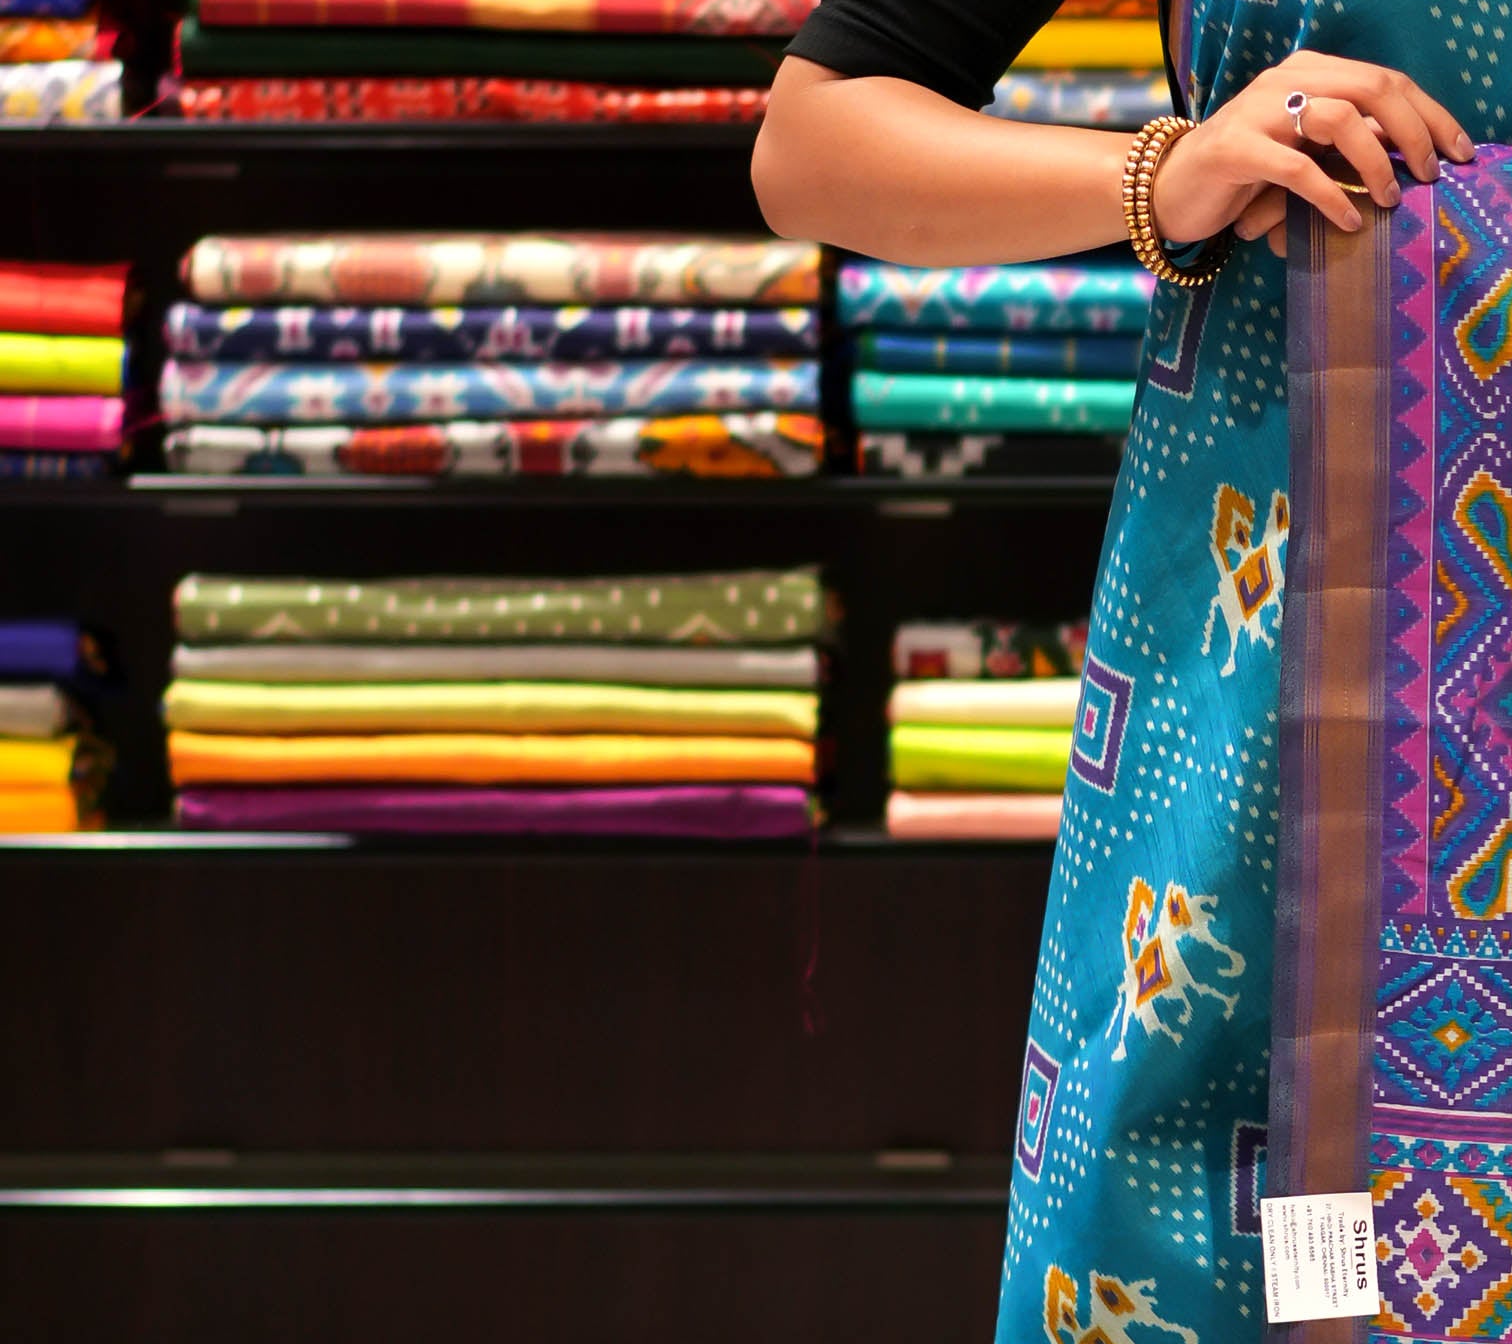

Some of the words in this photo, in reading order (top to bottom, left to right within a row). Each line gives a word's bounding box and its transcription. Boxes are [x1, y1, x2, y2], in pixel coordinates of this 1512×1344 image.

[1337, 1211, 1345, 1233] Trade
[1353, 1219, 1369, 1290] Shrus
[1271, 1273, 1279, 1297] STEAM
[1340, 1269, 1349, 1298] Eternity
[1272, 1298, 1280, 1318] IRON
